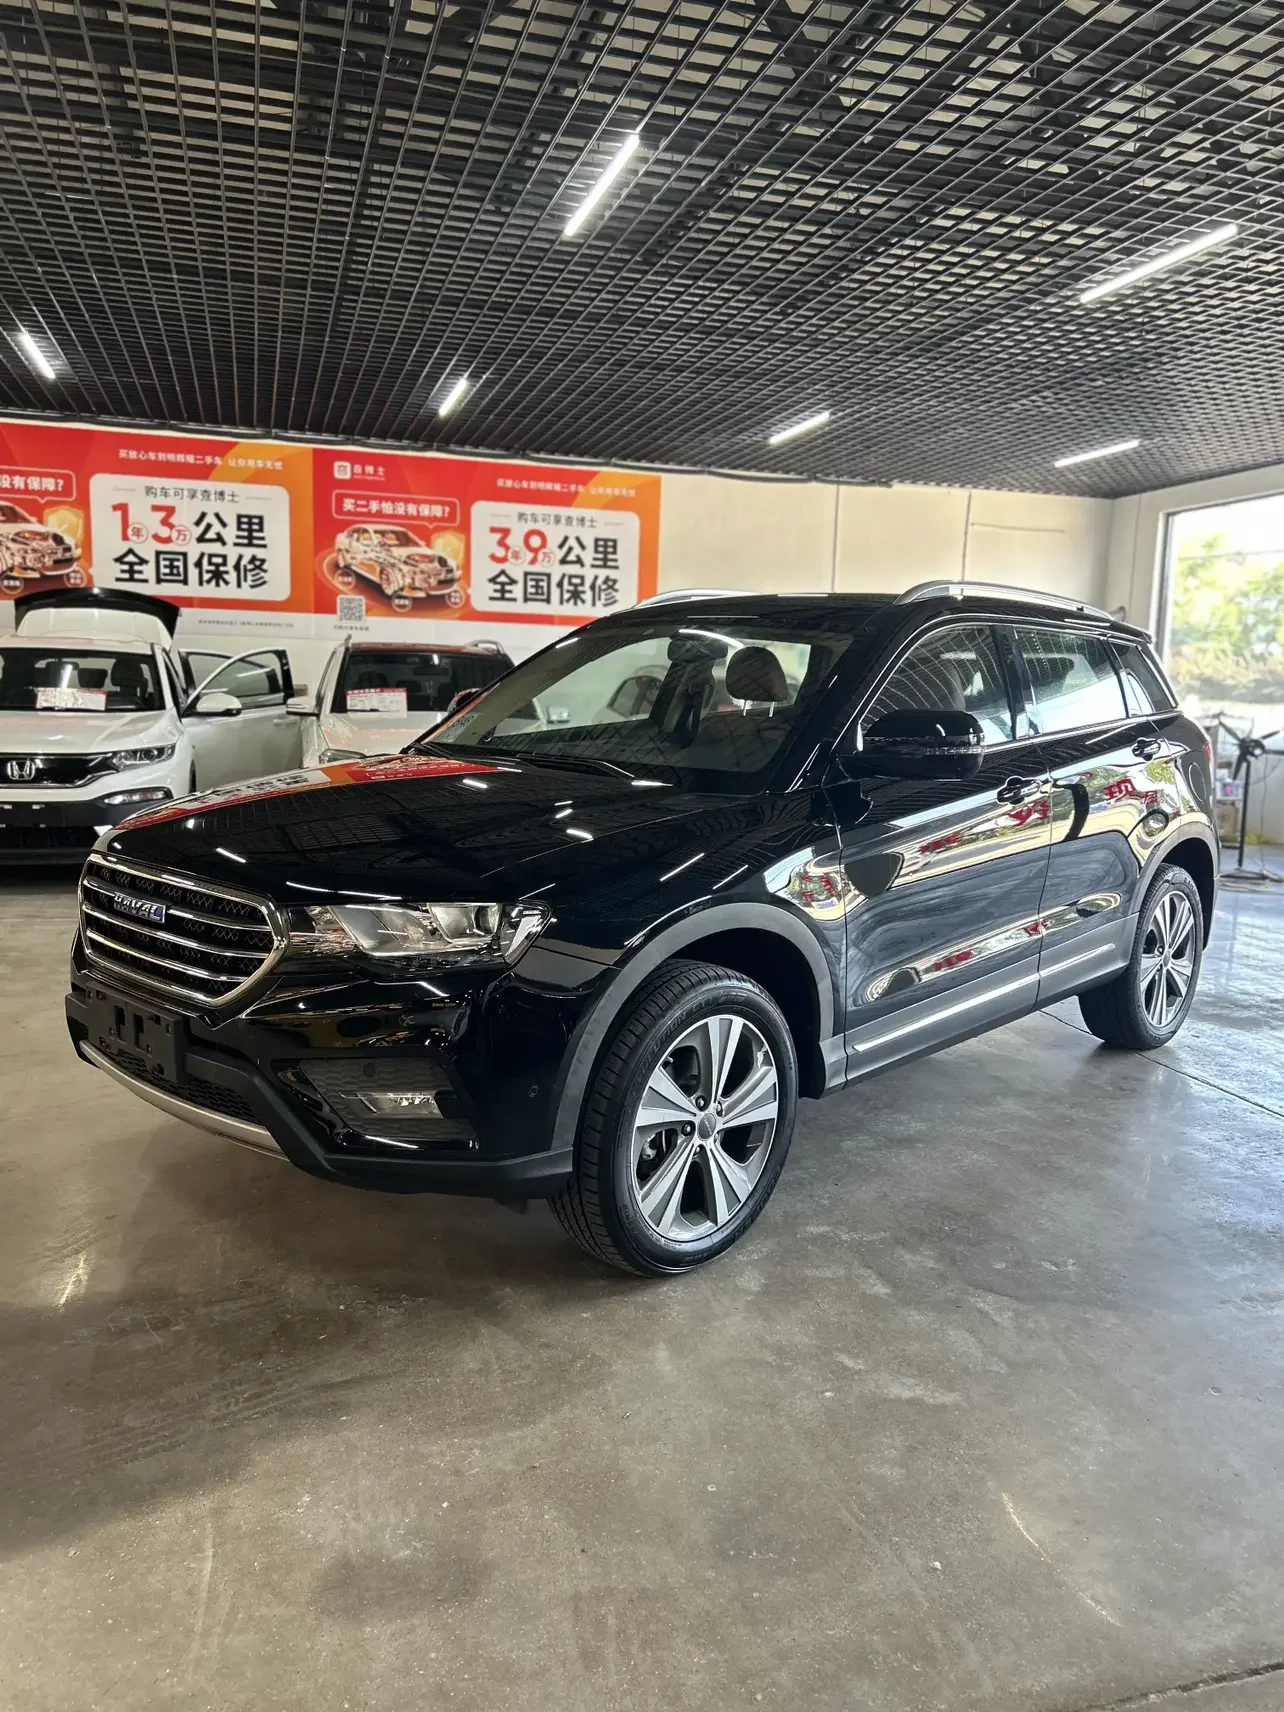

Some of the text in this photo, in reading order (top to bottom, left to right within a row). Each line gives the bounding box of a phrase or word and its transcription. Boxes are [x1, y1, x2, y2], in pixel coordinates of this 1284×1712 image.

[144, 485, 240, 503] 购车可享查博士
[517, 511, 598, 529] 购车可享查博士
[112, 547, 269, 589] 全国保修
[488, 569, 620, 609] 全国保修
[114, 893, 162, 920] HAVAL
